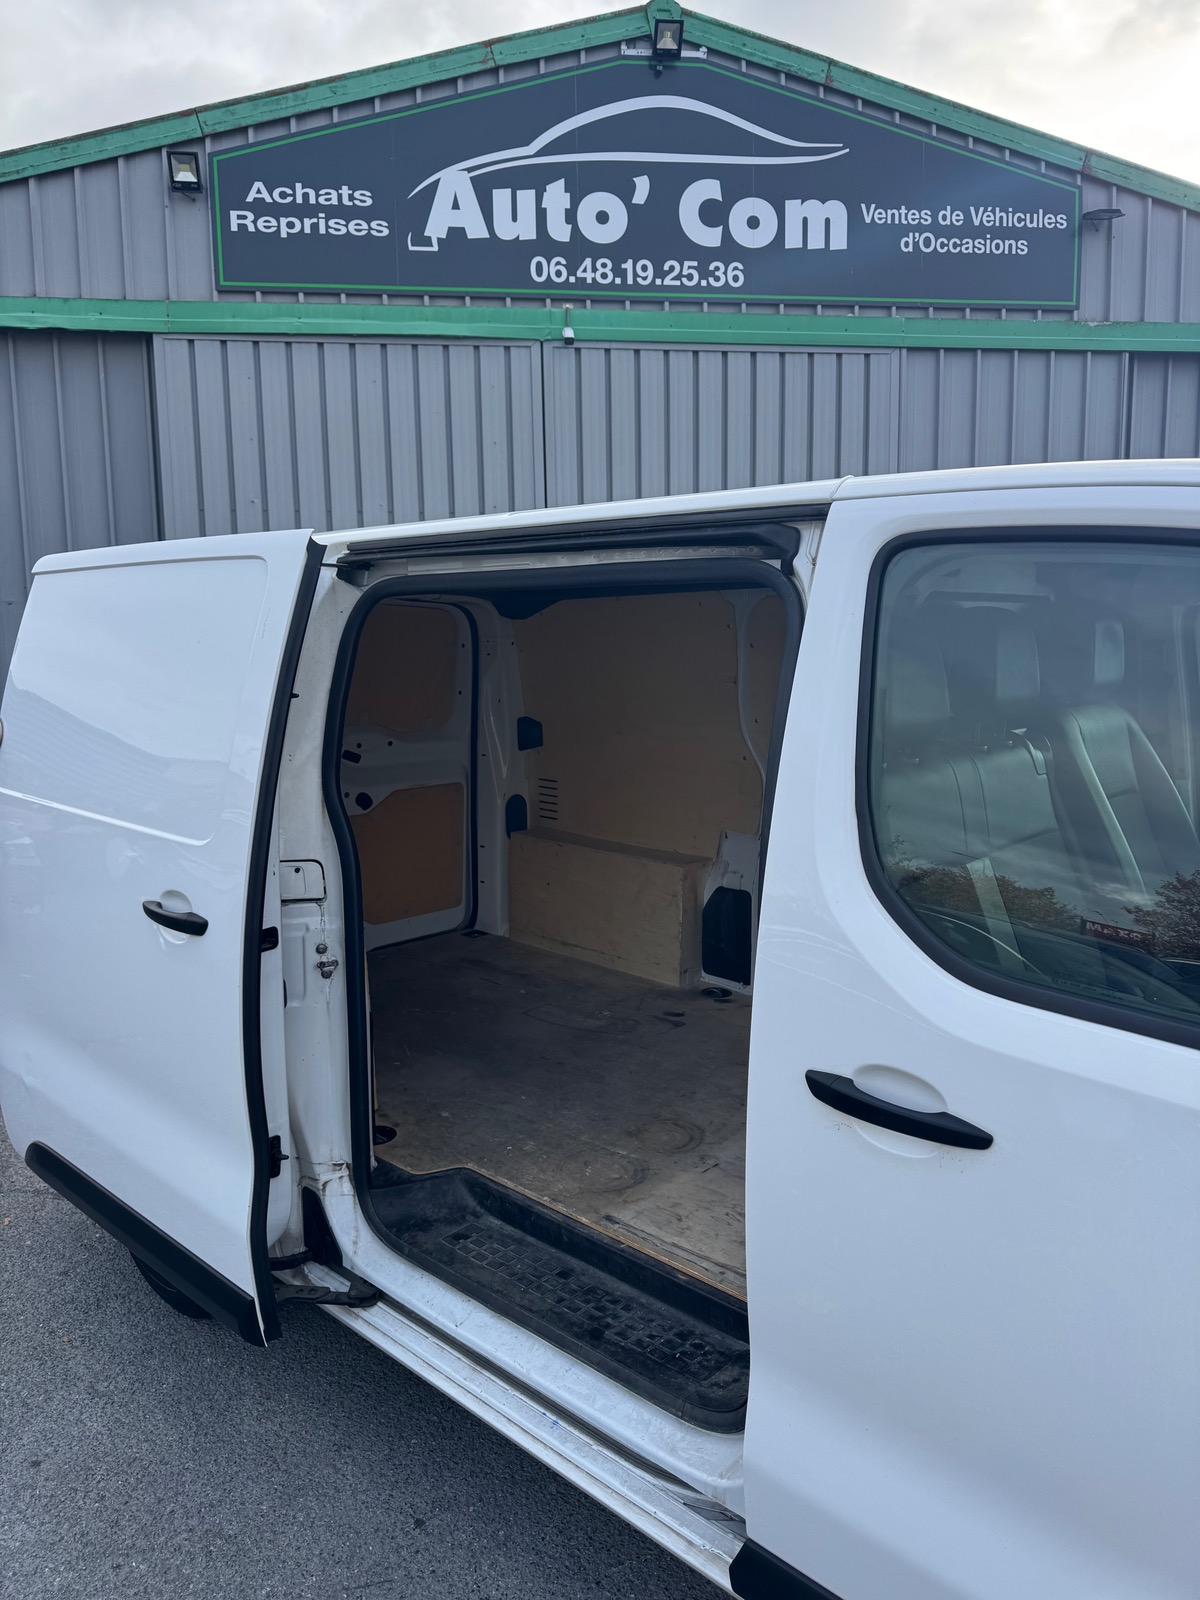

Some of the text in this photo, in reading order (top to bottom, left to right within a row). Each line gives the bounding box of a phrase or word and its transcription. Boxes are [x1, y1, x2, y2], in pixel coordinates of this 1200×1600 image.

[245, 181, 373, 207] Achats
[424, 170, 848, 250] Auto' Com
[860, 203, 1068, 229] Ventes de Véhicules
[229, 210, 390, 238] Reprises
[900, 232, 1028, 255] d'Occasions
[530, 256, 745, 288] 06.48.19.25.36
